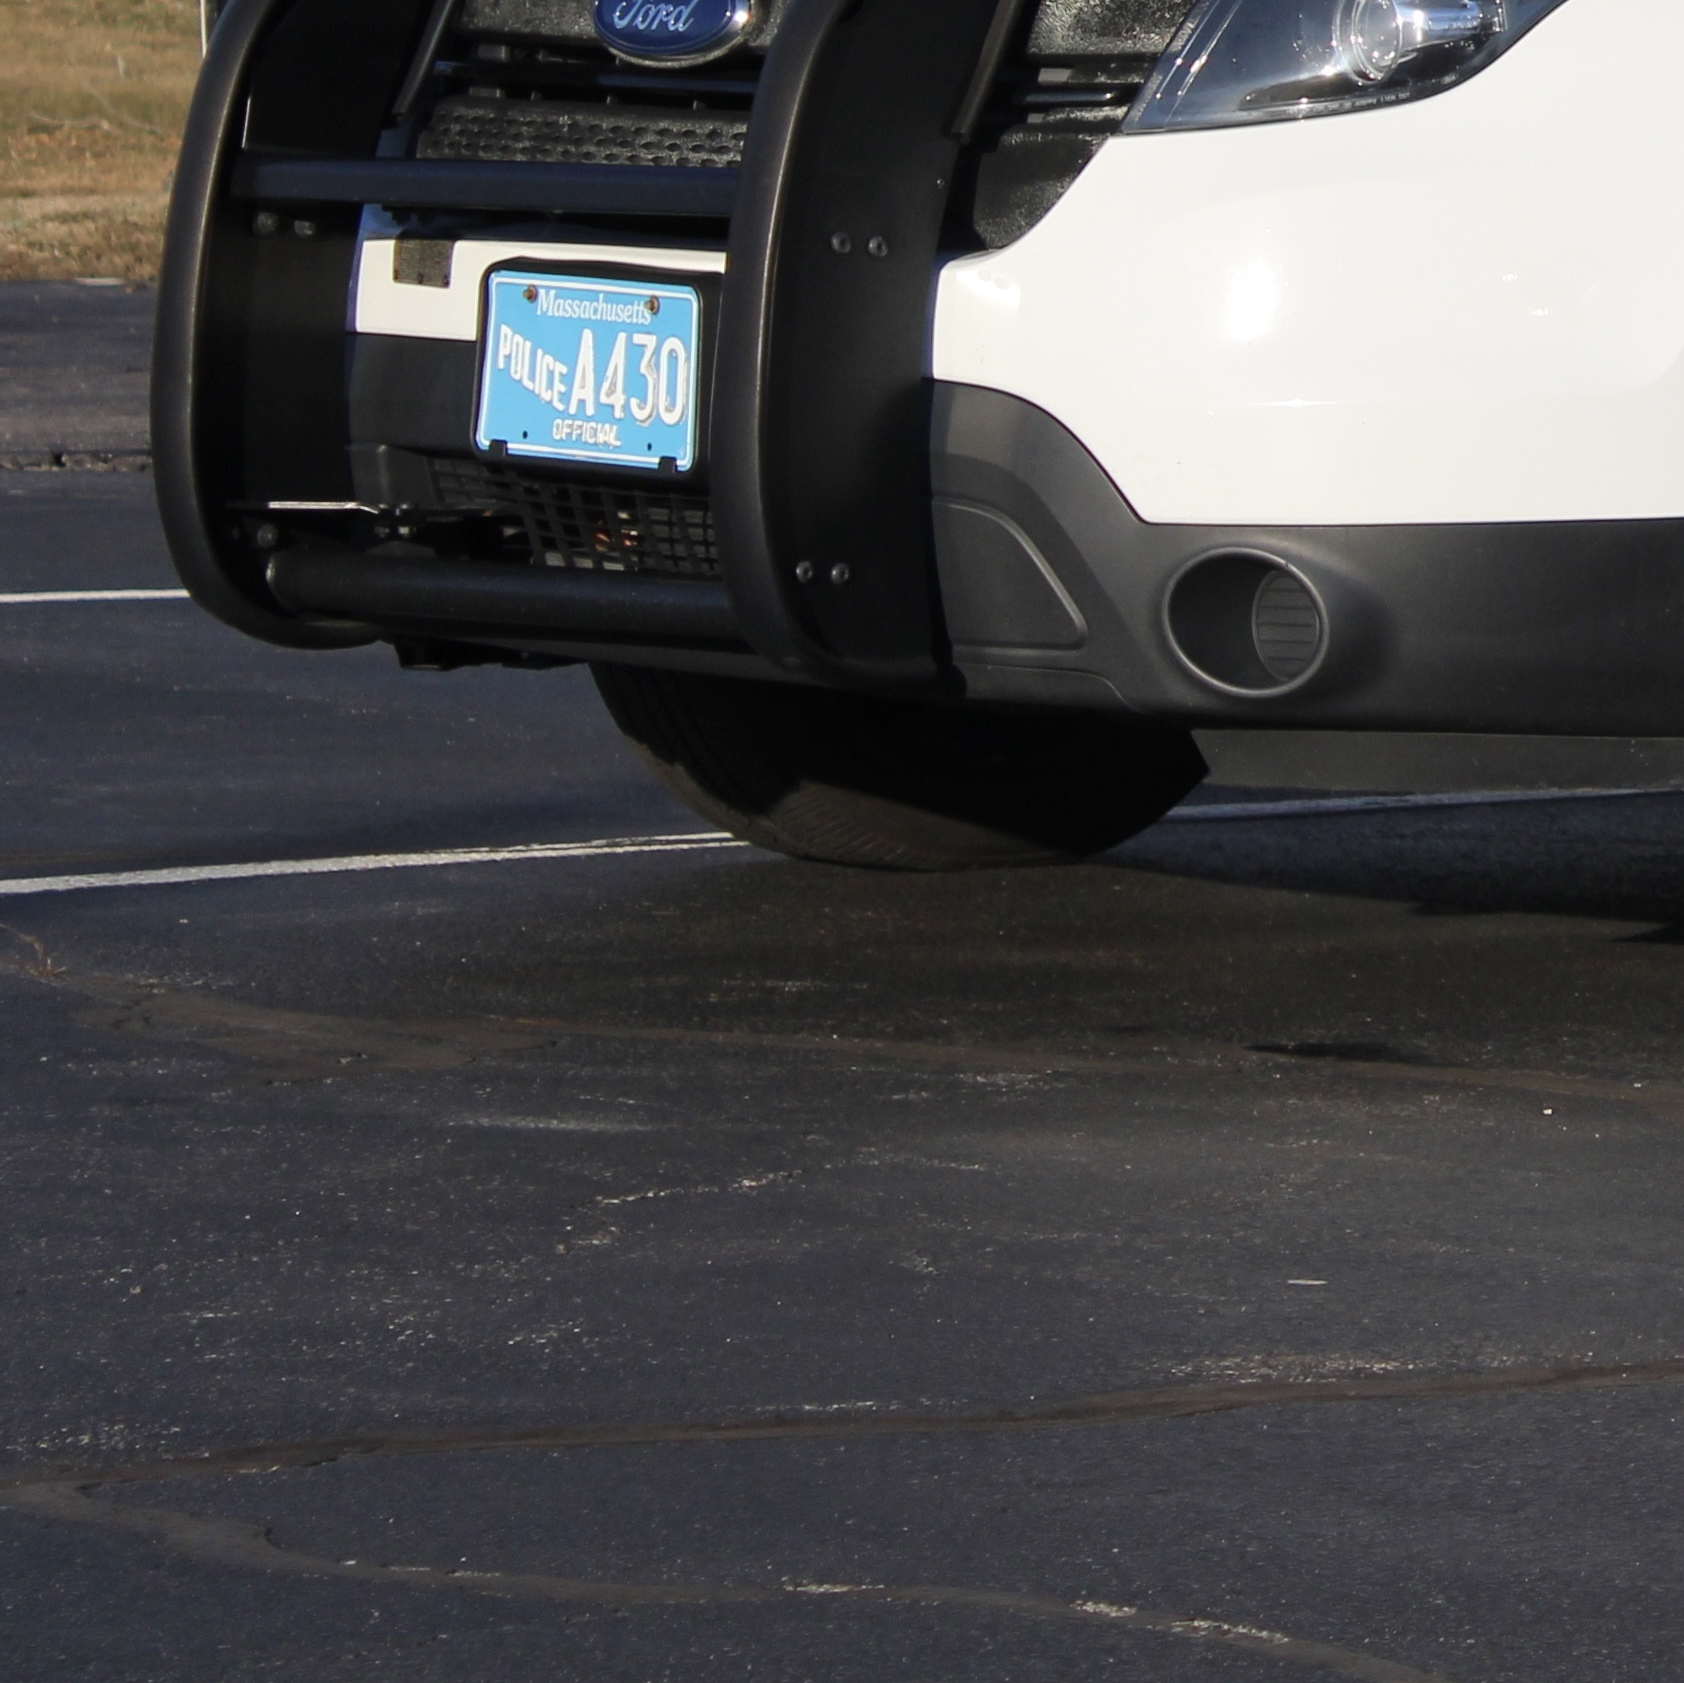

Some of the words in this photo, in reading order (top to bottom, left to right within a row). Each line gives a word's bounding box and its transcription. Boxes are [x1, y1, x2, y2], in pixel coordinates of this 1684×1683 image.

[536, 288, 652, 325] Massachusetts
[497, 323, 568, 412] POLICE
[568, 327, 688, 426] A430
[552, 417, 622, 448] OFFICIAL
